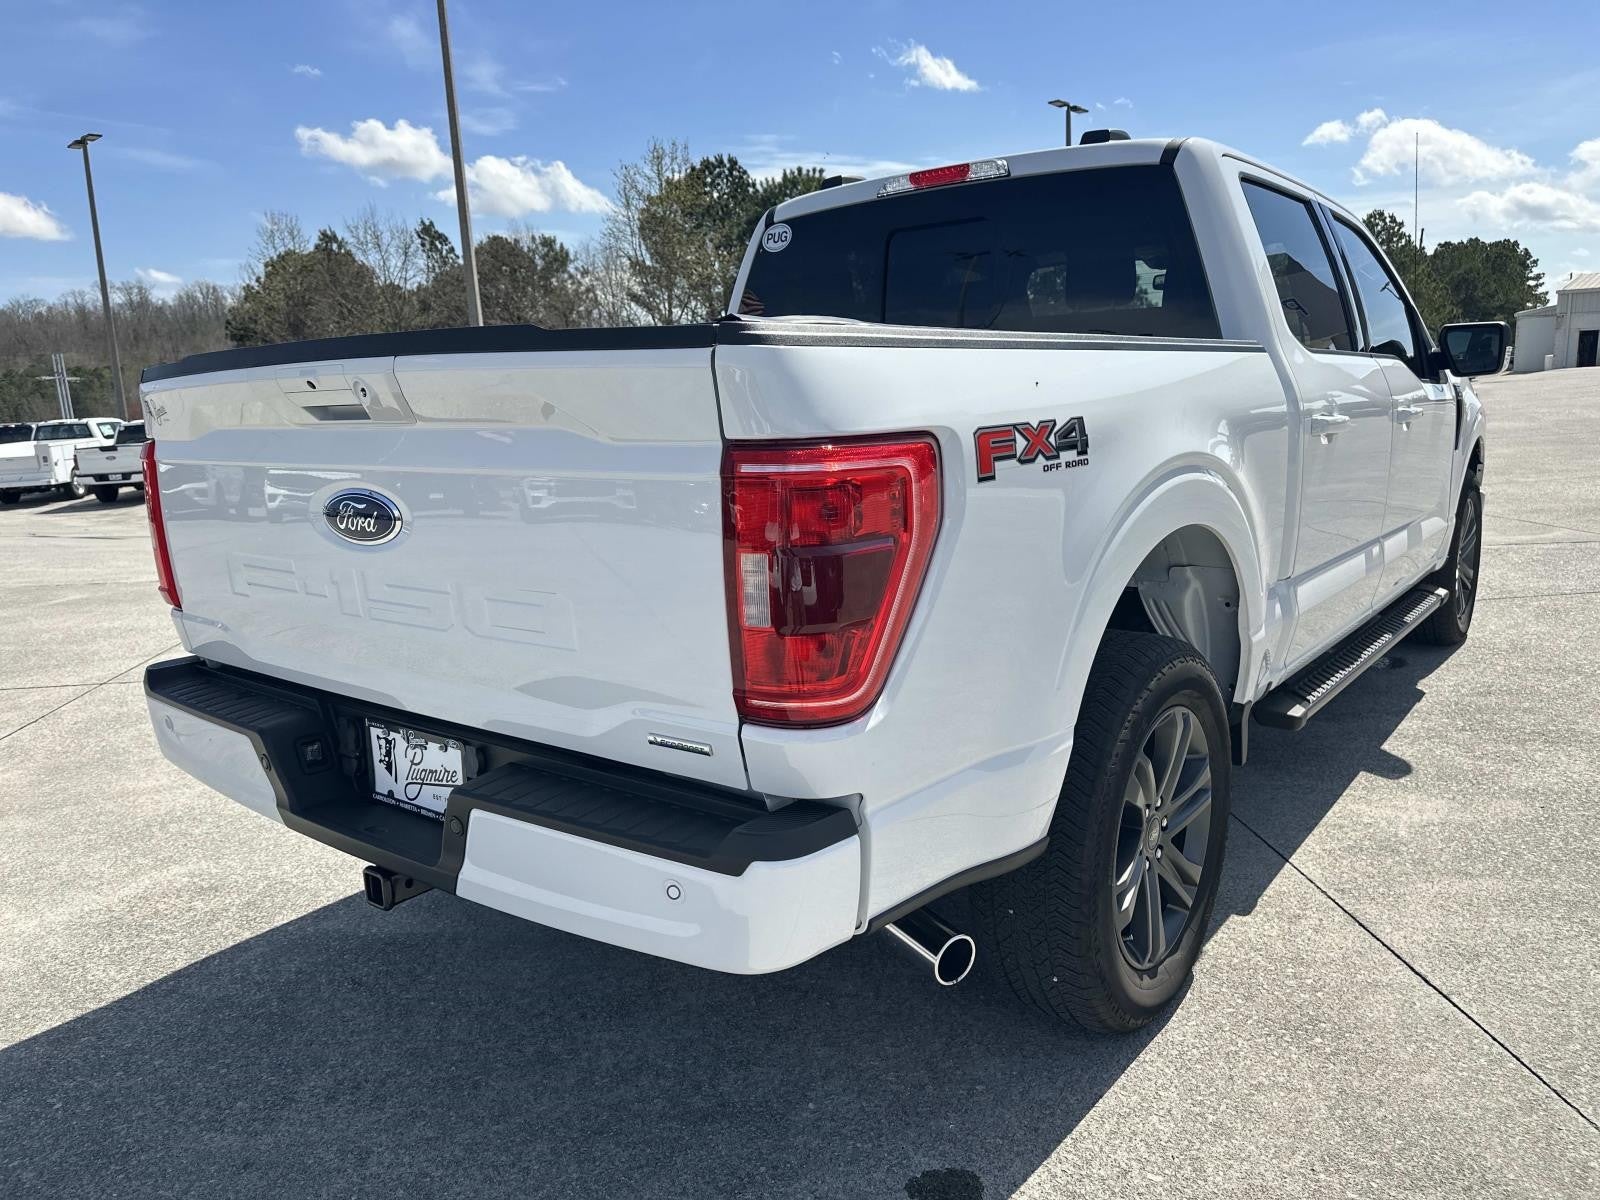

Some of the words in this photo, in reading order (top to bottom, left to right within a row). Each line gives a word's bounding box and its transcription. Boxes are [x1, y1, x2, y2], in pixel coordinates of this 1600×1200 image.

[766, 230, 788, 244] PUG
[973, 416, 1089, 482] FX4
[1043, 462, 1062, 472] OFF
[1065, 458, 1089, 469] ROAD
[336, 500, 378, 532] Ford
[226, 552, 577, 651] F-150
[404, 745, 459, 801] Pugmire
